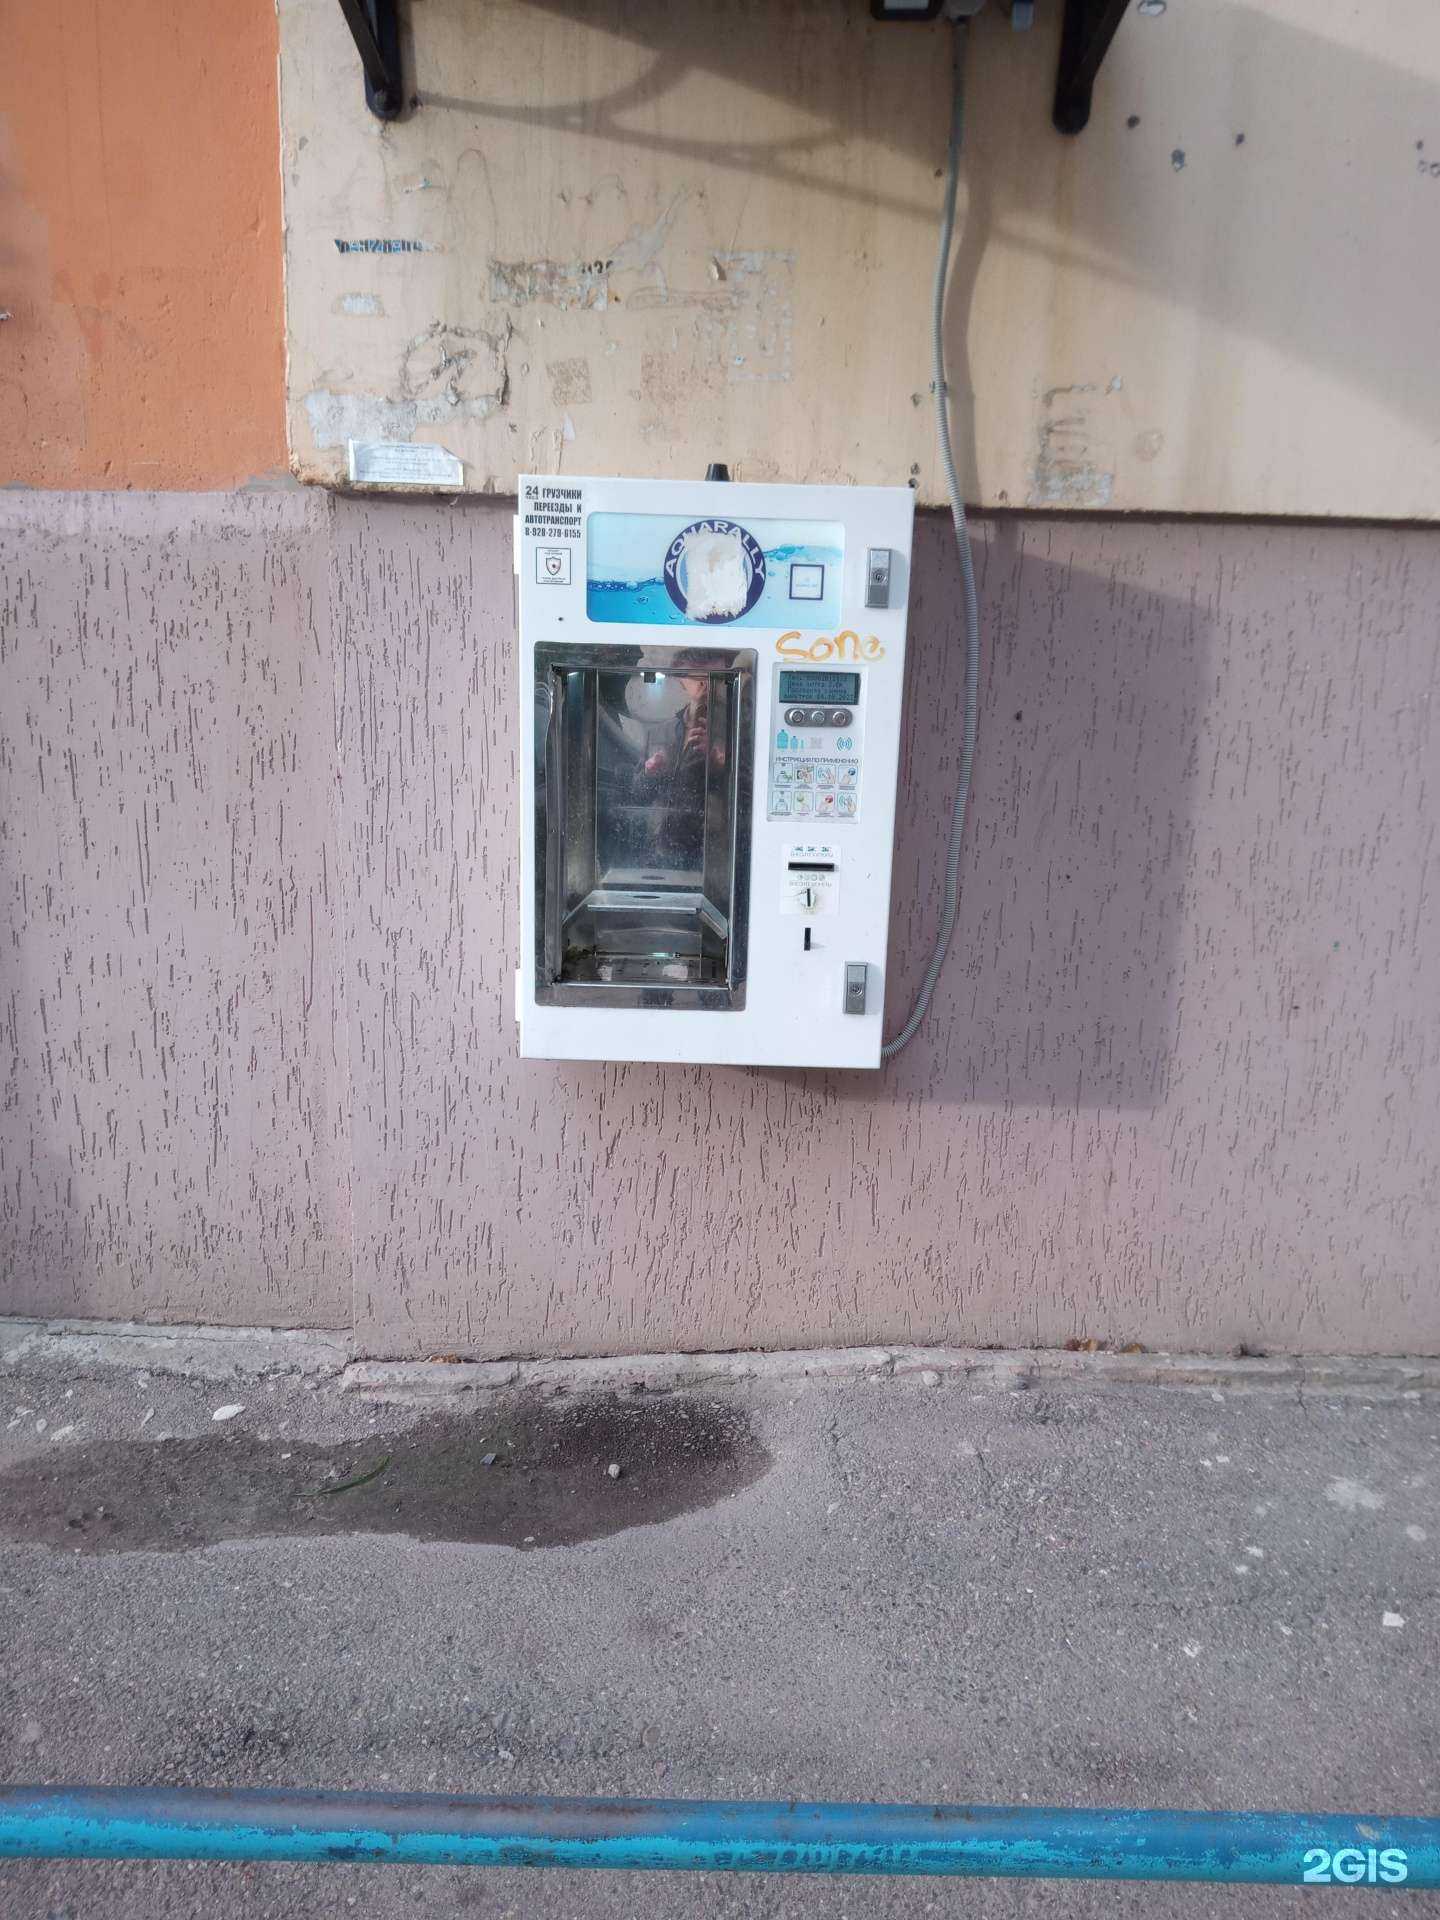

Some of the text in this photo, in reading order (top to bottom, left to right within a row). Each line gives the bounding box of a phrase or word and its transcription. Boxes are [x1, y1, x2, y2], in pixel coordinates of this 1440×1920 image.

[525, 485, 582, 500] 24 ГРУЗЧИКИ
[534, 502, 582, 514] ПЕРЕЕЗДЫ И
[525, 514, 582, 526] АВТОТРАНСПОРТ
